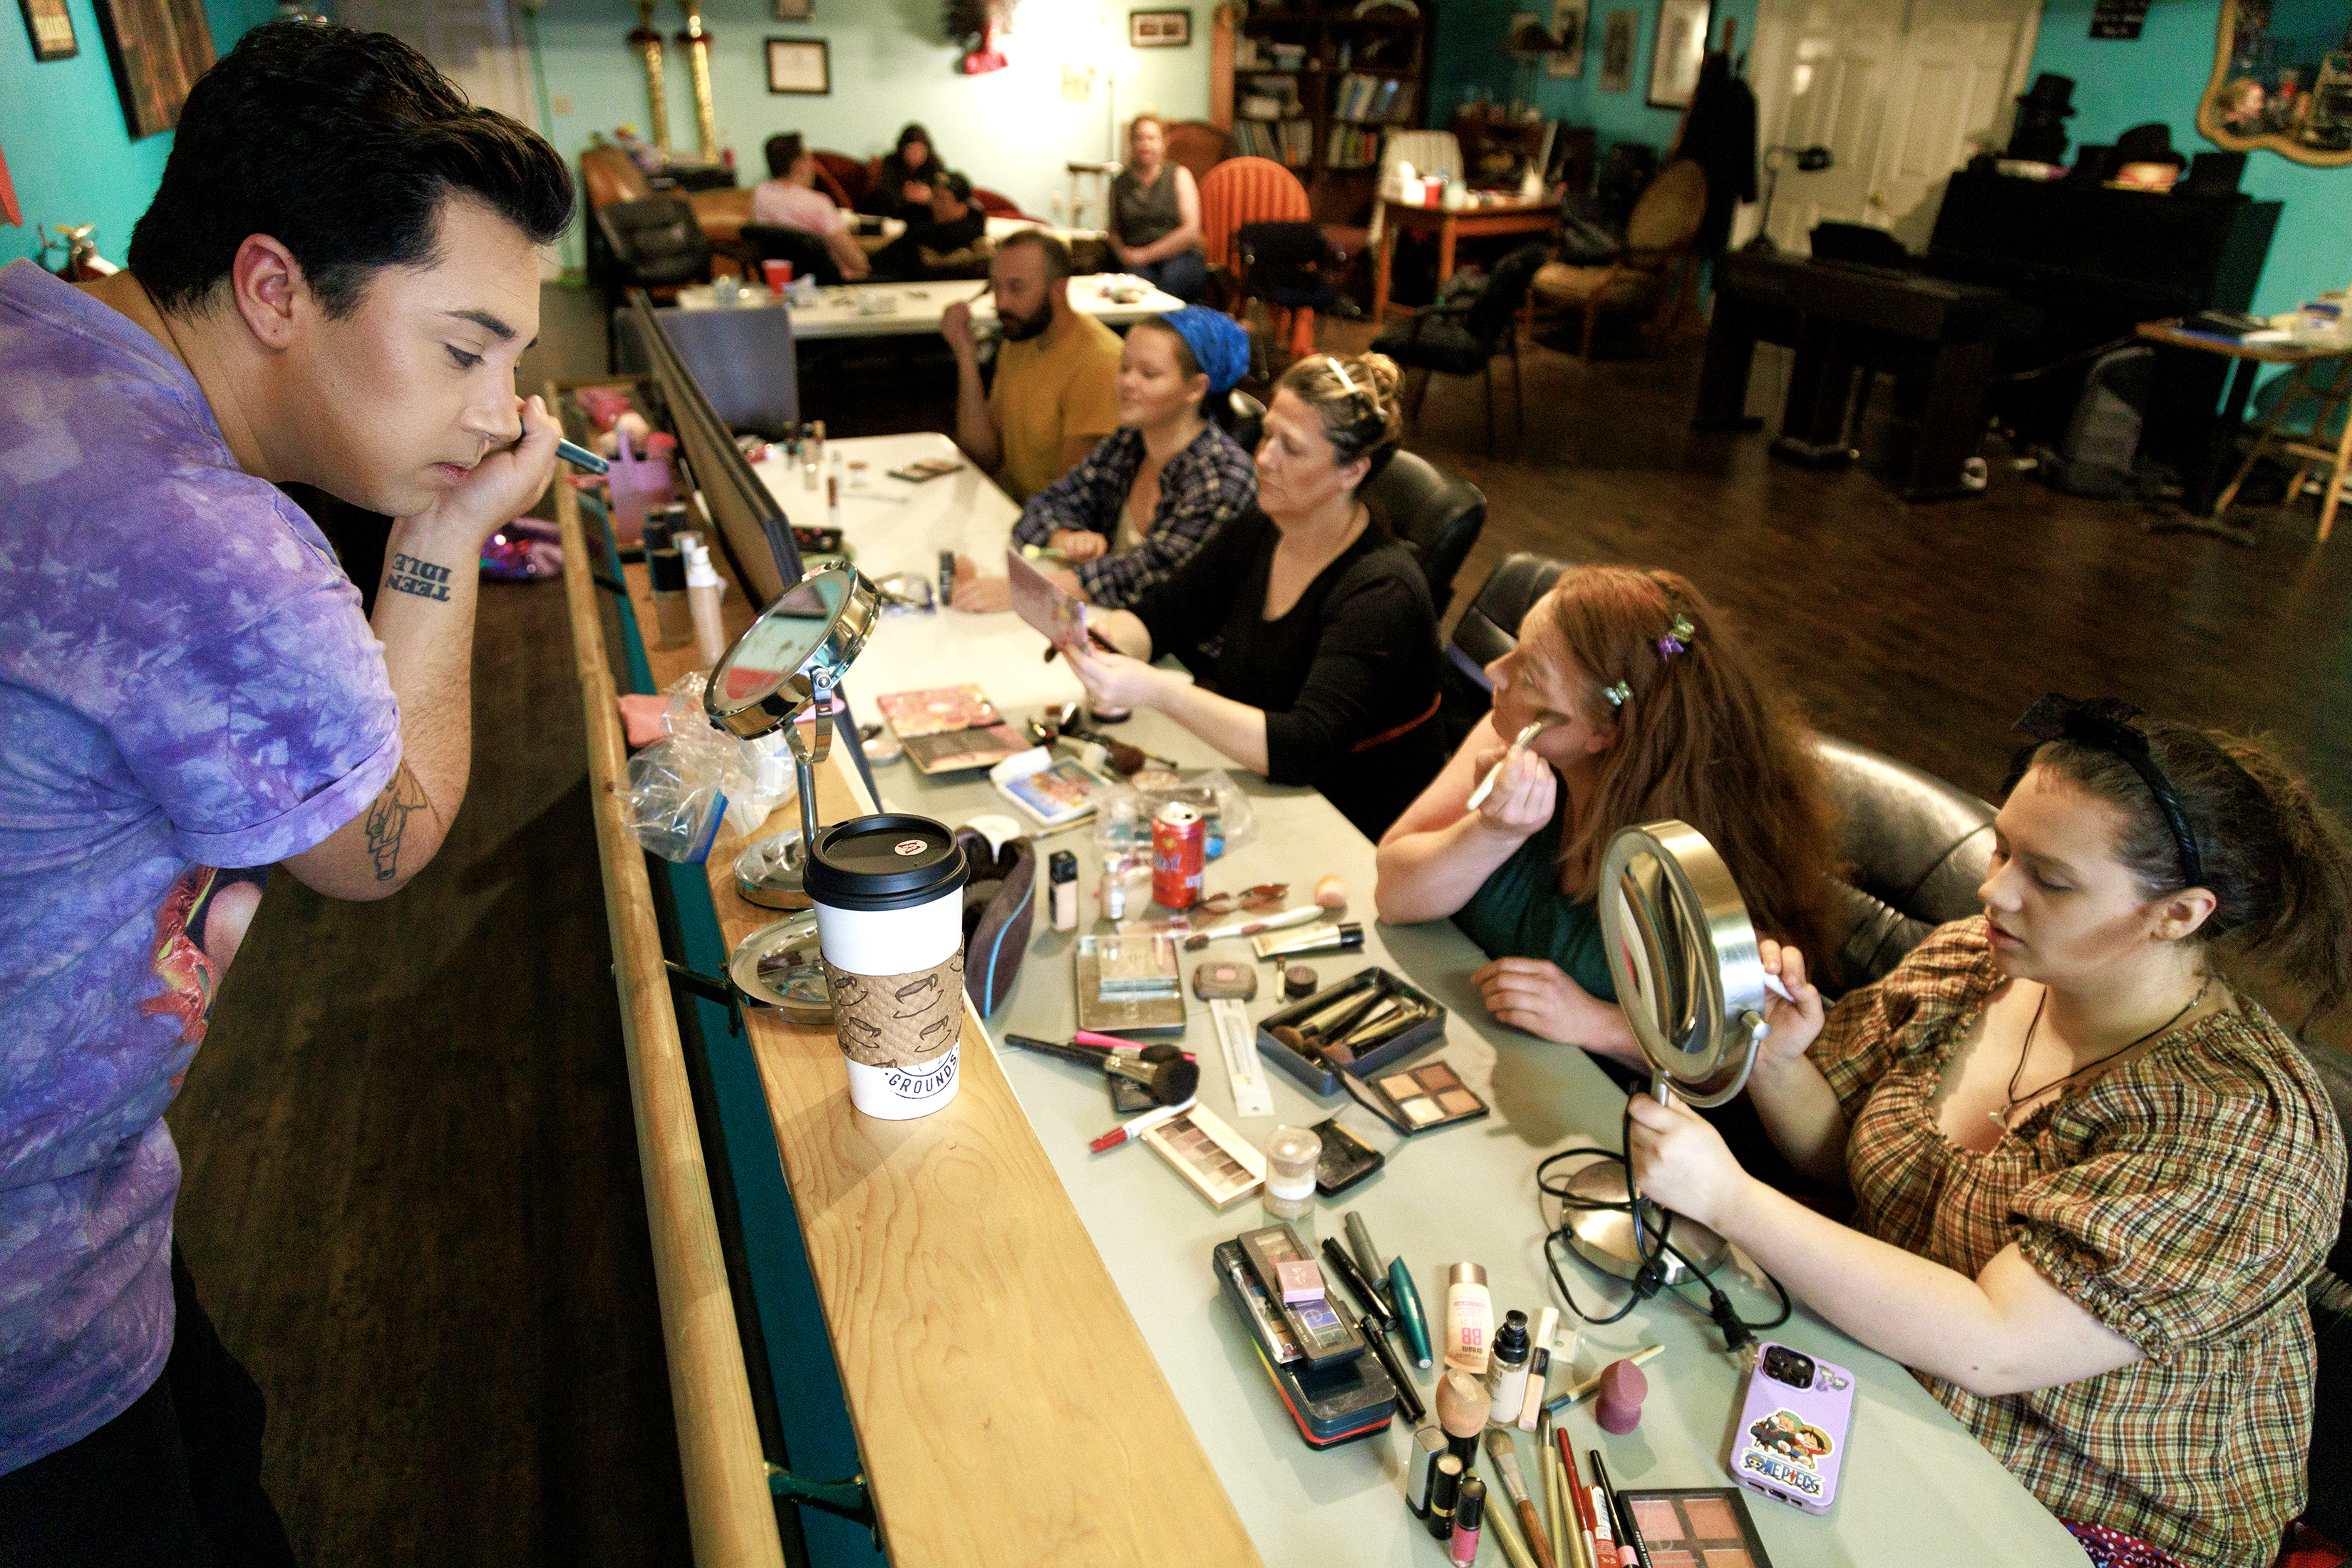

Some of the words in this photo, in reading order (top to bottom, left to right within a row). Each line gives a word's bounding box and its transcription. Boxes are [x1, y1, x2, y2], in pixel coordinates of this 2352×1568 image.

[392, 552, 451, 583] IDLE
[386, 574, 450, 602] TEEN
[888, 1054, 956, 1094] GROUNDS
[1461, 1318, 1482, 1327] FRESH
[1461, 1327, 1482, 1346] BB
[1462, 1346, 1484, 1354] dream
[1745, 1453, 1783, 1478] ONE
[1782, 1465, 1821, 1492] PIECE
[1635, 1531, 1646, 1552] POWDER
